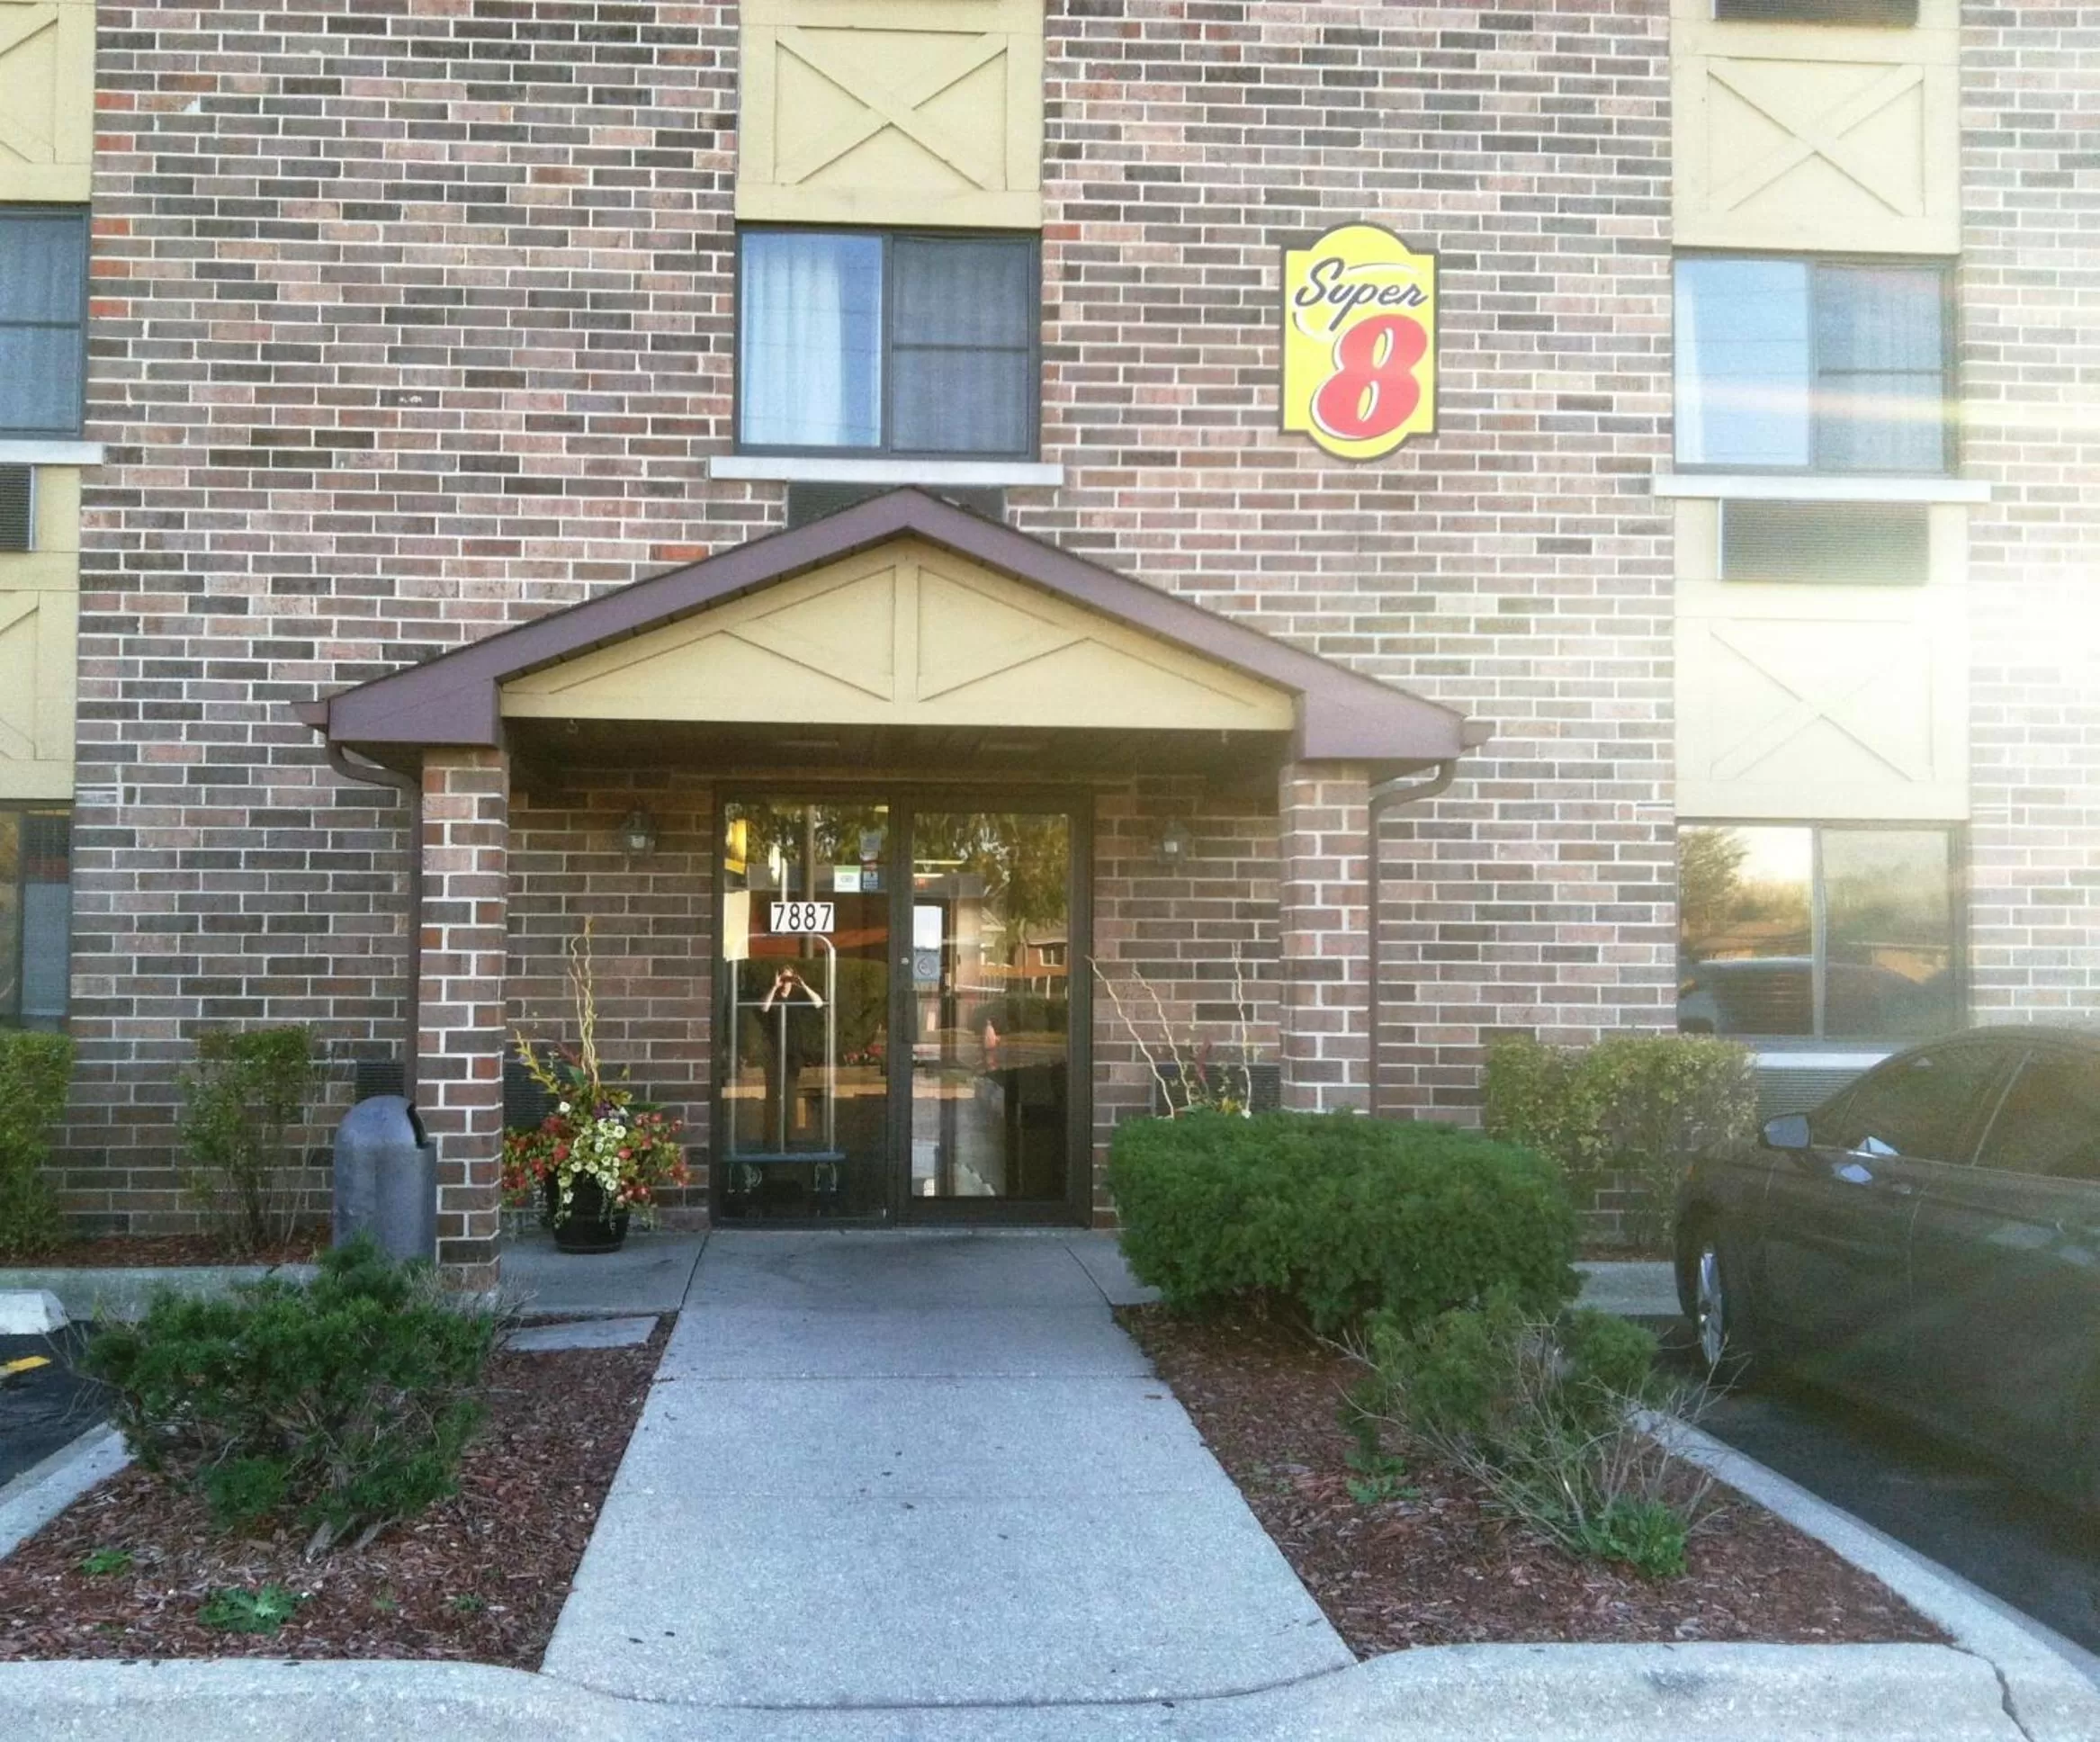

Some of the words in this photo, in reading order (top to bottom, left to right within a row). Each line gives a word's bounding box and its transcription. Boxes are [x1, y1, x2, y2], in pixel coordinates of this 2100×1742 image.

[1295, 257, 1428, 331] Super
[1311, 314, 1428, 441] 8
[774, 903, 831, 930] 7887
